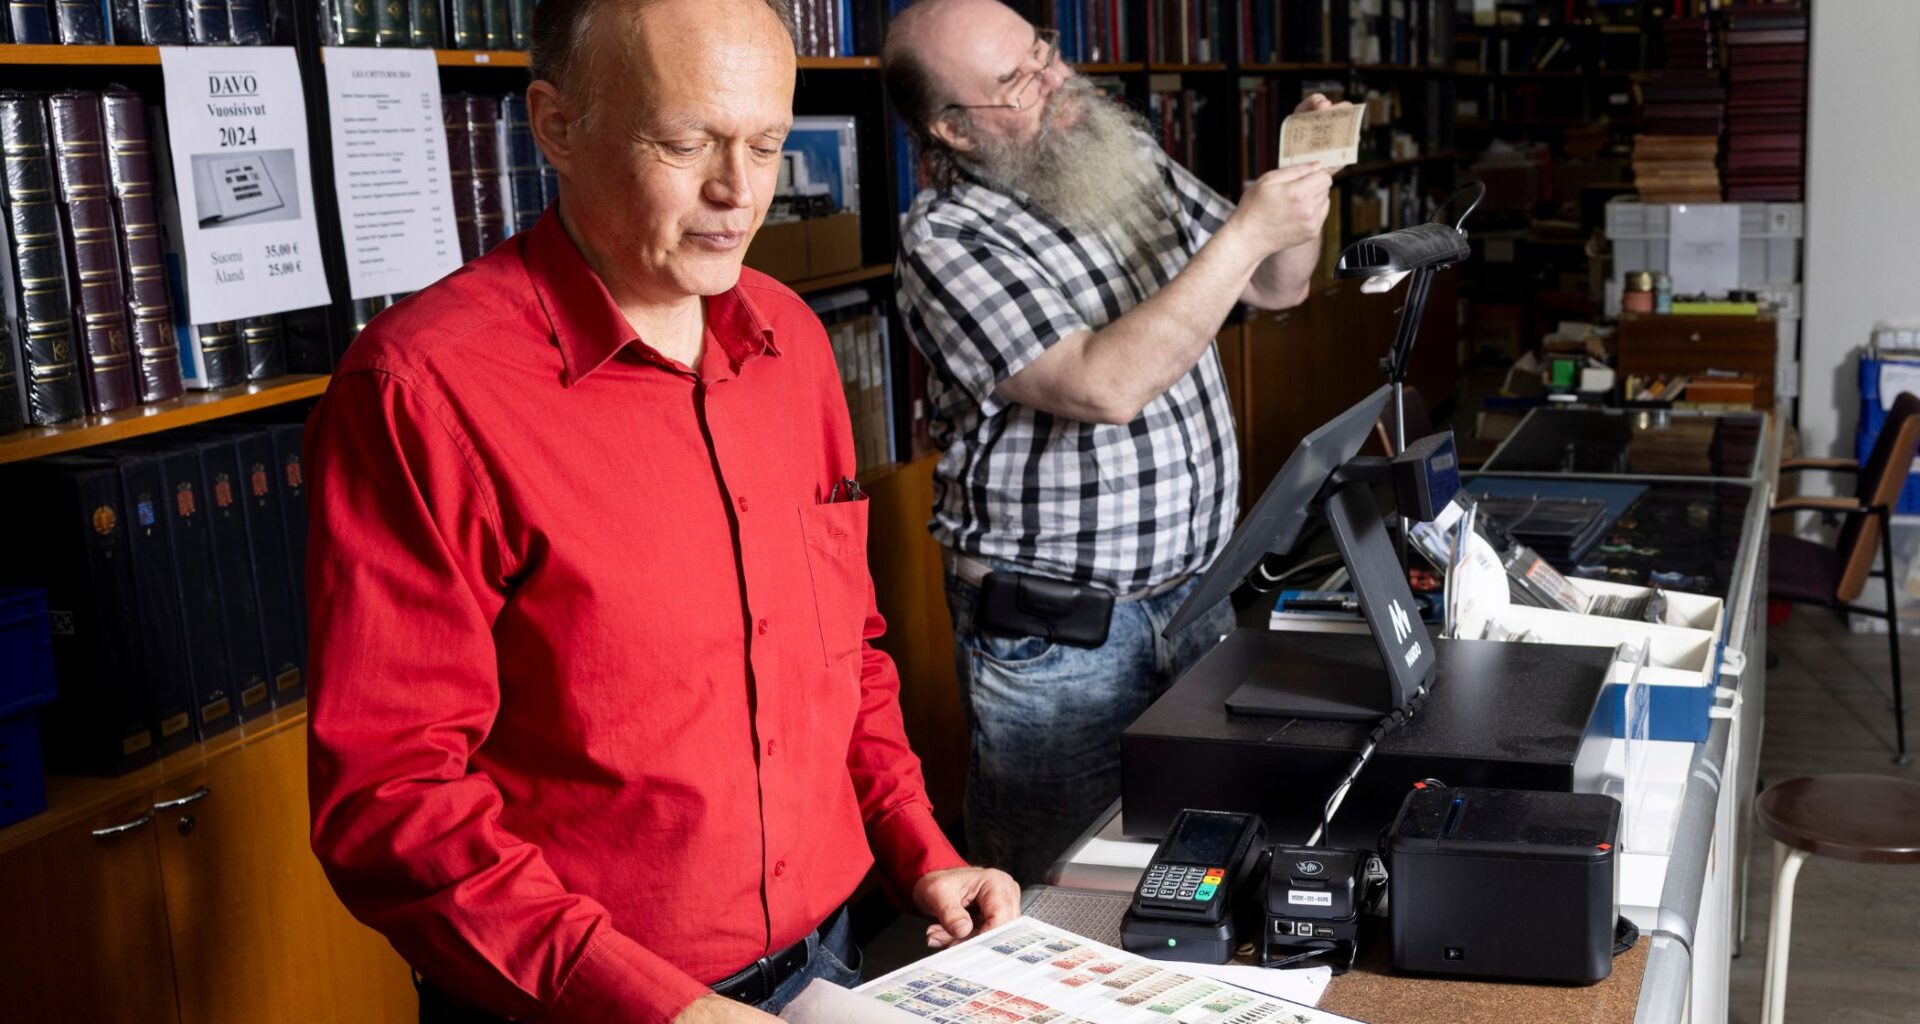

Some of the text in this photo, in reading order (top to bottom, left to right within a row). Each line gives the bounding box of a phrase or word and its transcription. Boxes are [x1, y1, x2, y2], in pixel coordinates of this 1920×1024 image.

[209, 75, 258, 95] DAVO
[207, 102, 266, 117] Vuosisivut
[219, 126, 257, 147] 2024
[211, 242, 299, 265] Suomi 35,00 €
[215, 261, 302, 284] Åland 25,00 €
